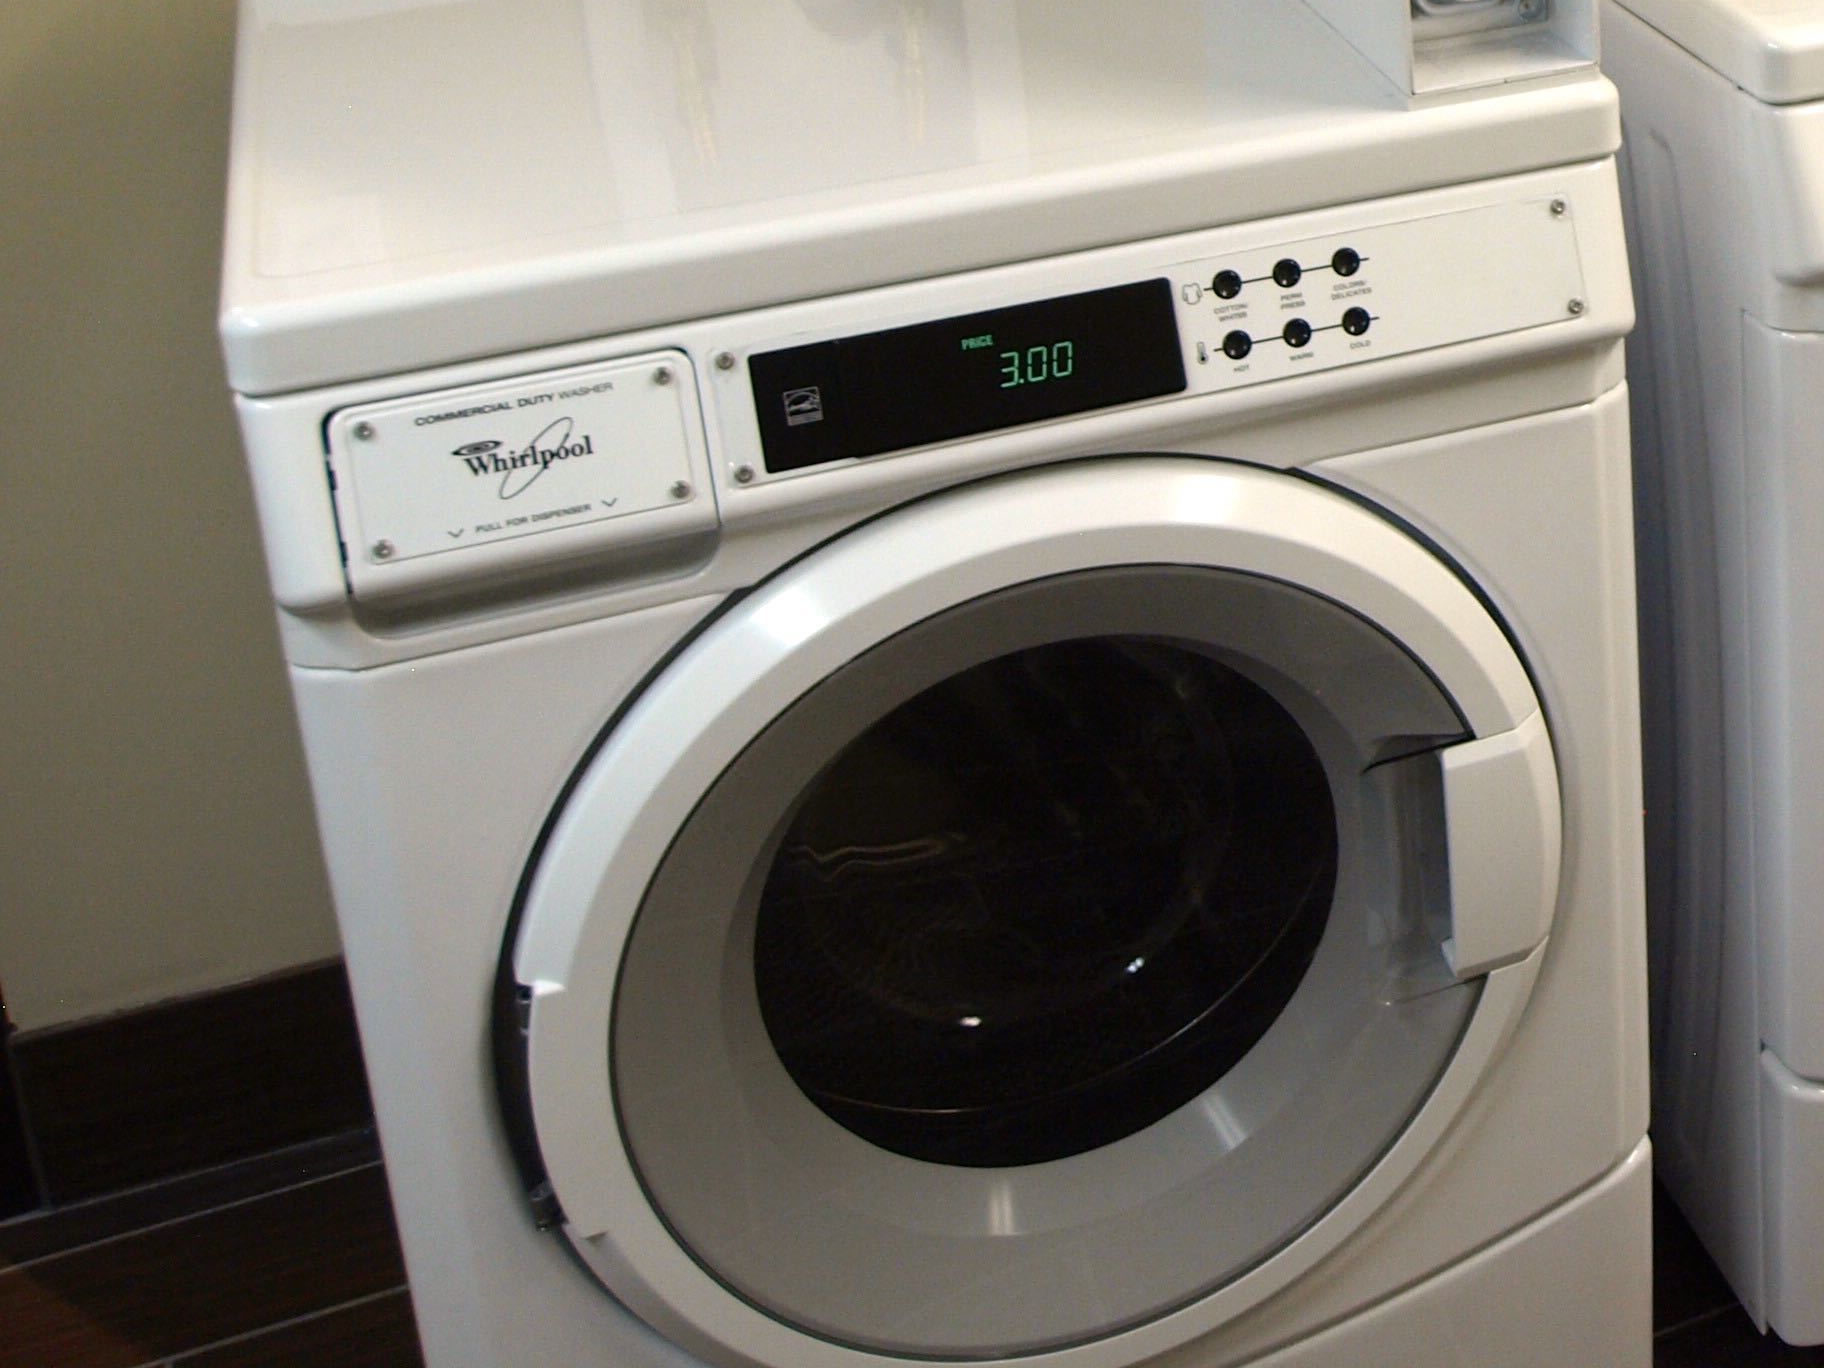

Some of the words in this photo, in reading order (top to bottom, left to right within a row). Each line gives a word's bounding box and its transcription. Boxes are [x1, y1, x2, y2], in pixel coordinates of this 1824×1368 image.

[961, 334, 993, 350] PRICE
[1000, 341, 1073, 388] 3.00
[414, 400, 513, 427] COMMERCIAL
[516, 392, 554, 408] DUTY
[558, 382, 614, 400] WASHER
[463, 435, 594, 478] Whirlpool
[475, 522, 503, 533] PULL
[505, 515, 528, 527] FOR
[531, 503, 592, 522] DISPENSER
